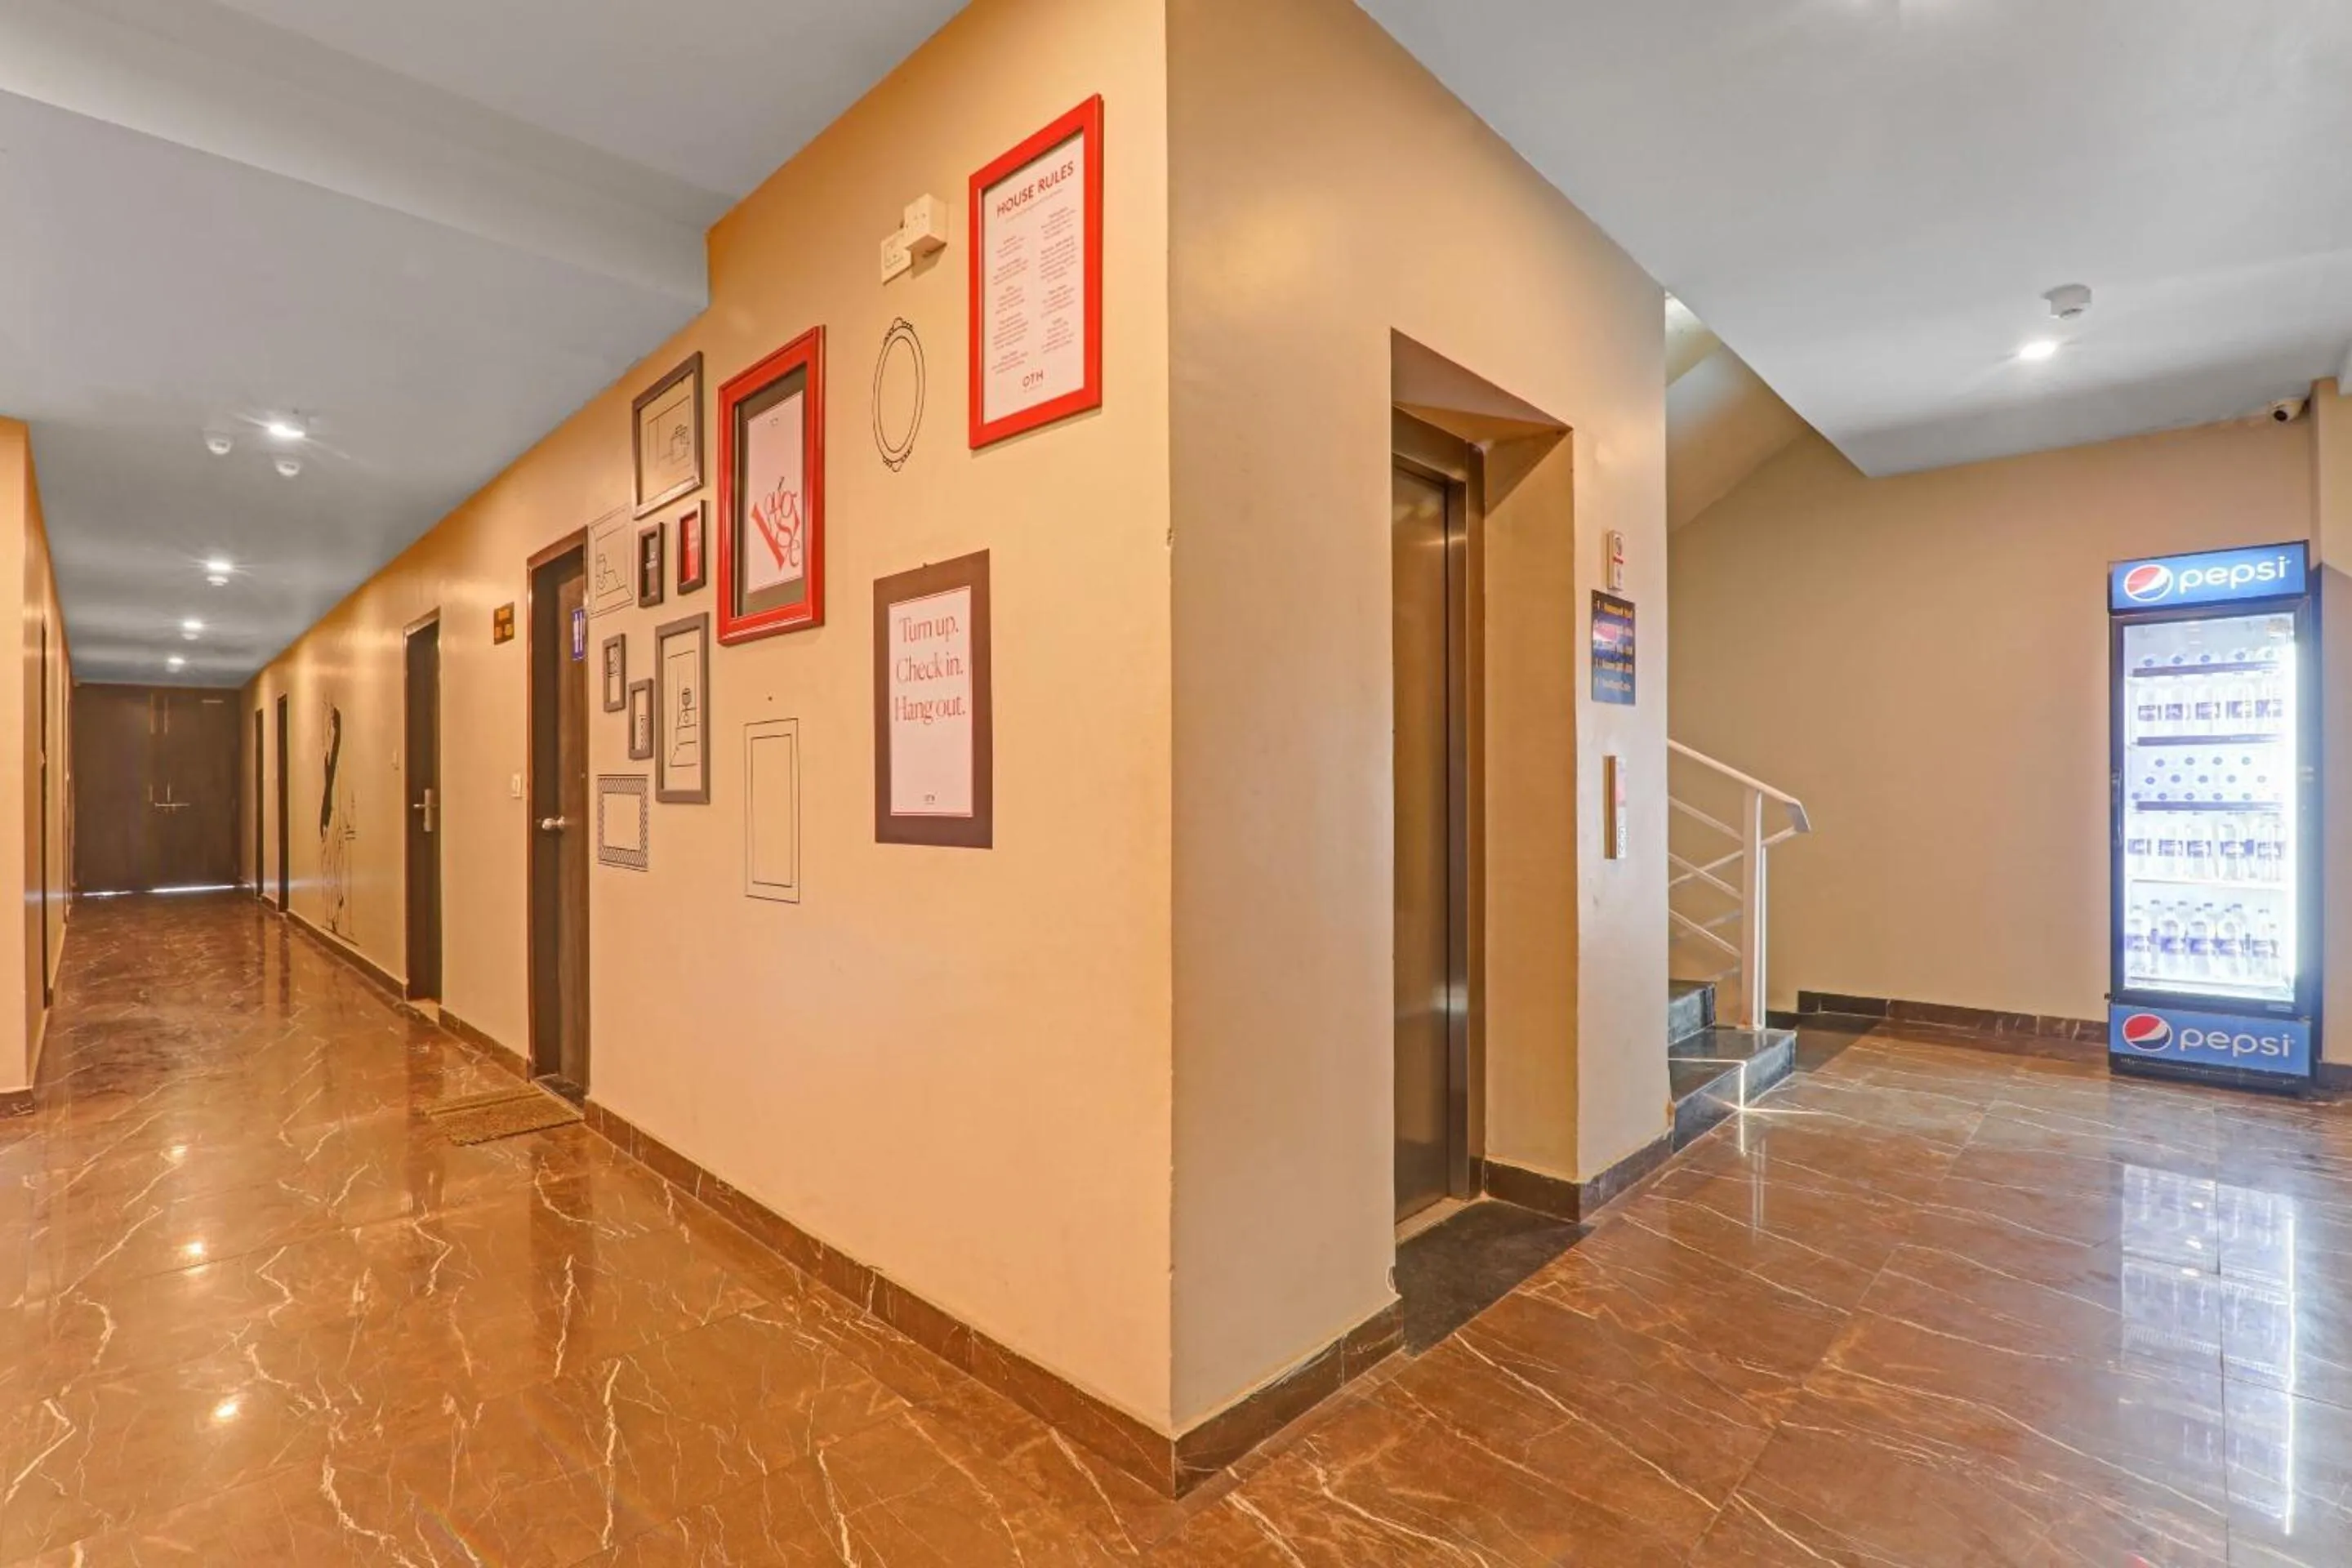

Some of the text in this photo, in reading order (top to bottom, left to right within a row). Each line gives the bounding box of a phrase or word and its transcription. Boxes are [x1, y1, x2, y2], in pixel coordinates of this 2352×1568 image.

[996, 185, 1035, 218] HOUSE
[1038, 160, 1074, 193] RULES
[2179, 555, 2286, 595] pepsi
[898, 616, 960, 644] Turn up.
[896, 651, 964, 684] Check in.
[895, 695, 966, 726] Hang out.
[2179, 1027, 2290, 1058] pepsi
